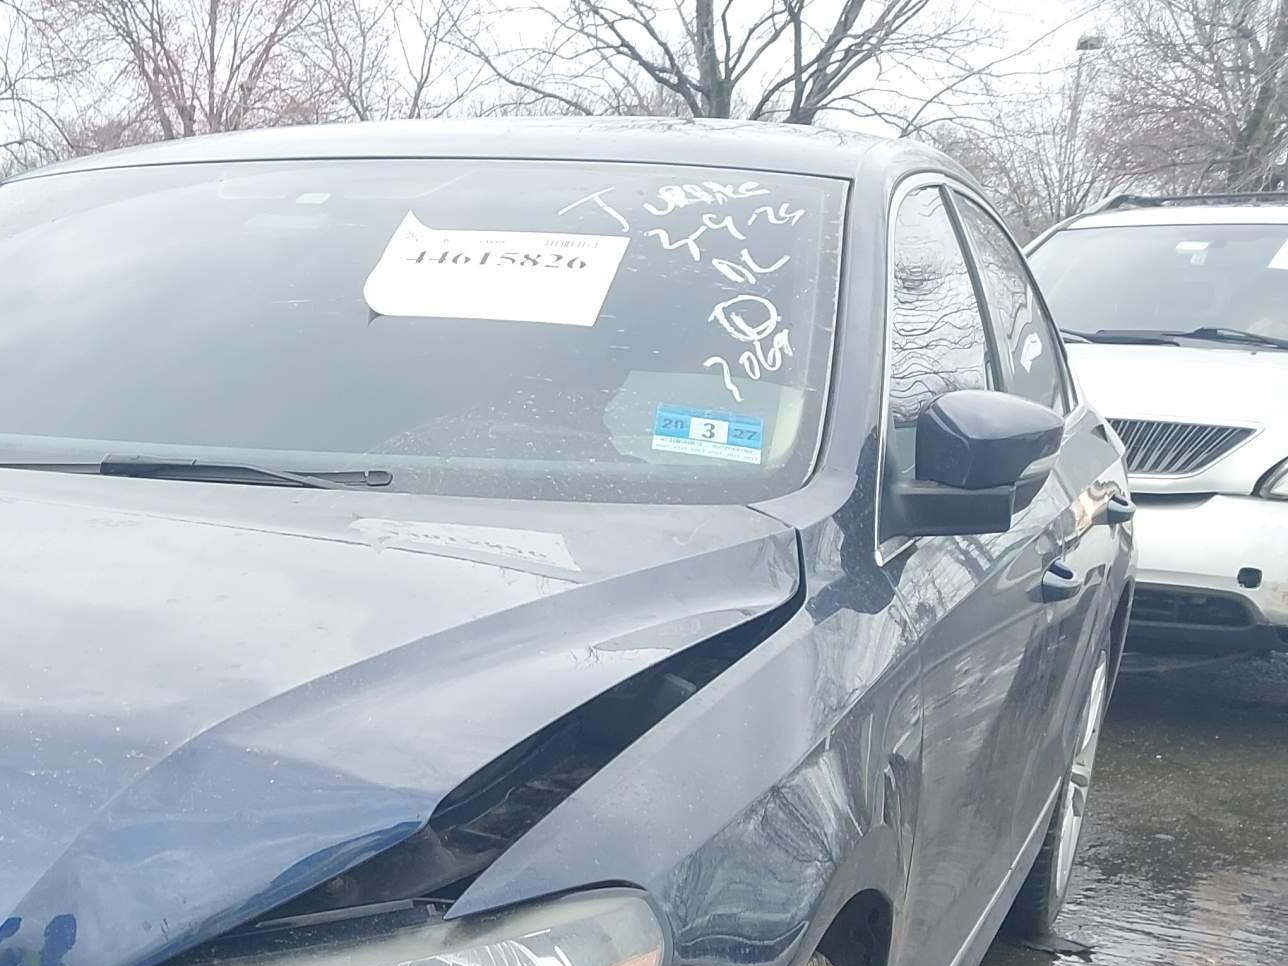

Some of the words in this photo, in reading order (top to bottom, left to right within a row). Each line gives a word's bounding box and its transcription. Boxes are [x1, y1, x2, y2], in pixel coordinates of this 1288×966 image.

[406, 250, 588, 270] 44615826
[701, 421, 717, 440] 3
[732, 427, 759, 441] 27
